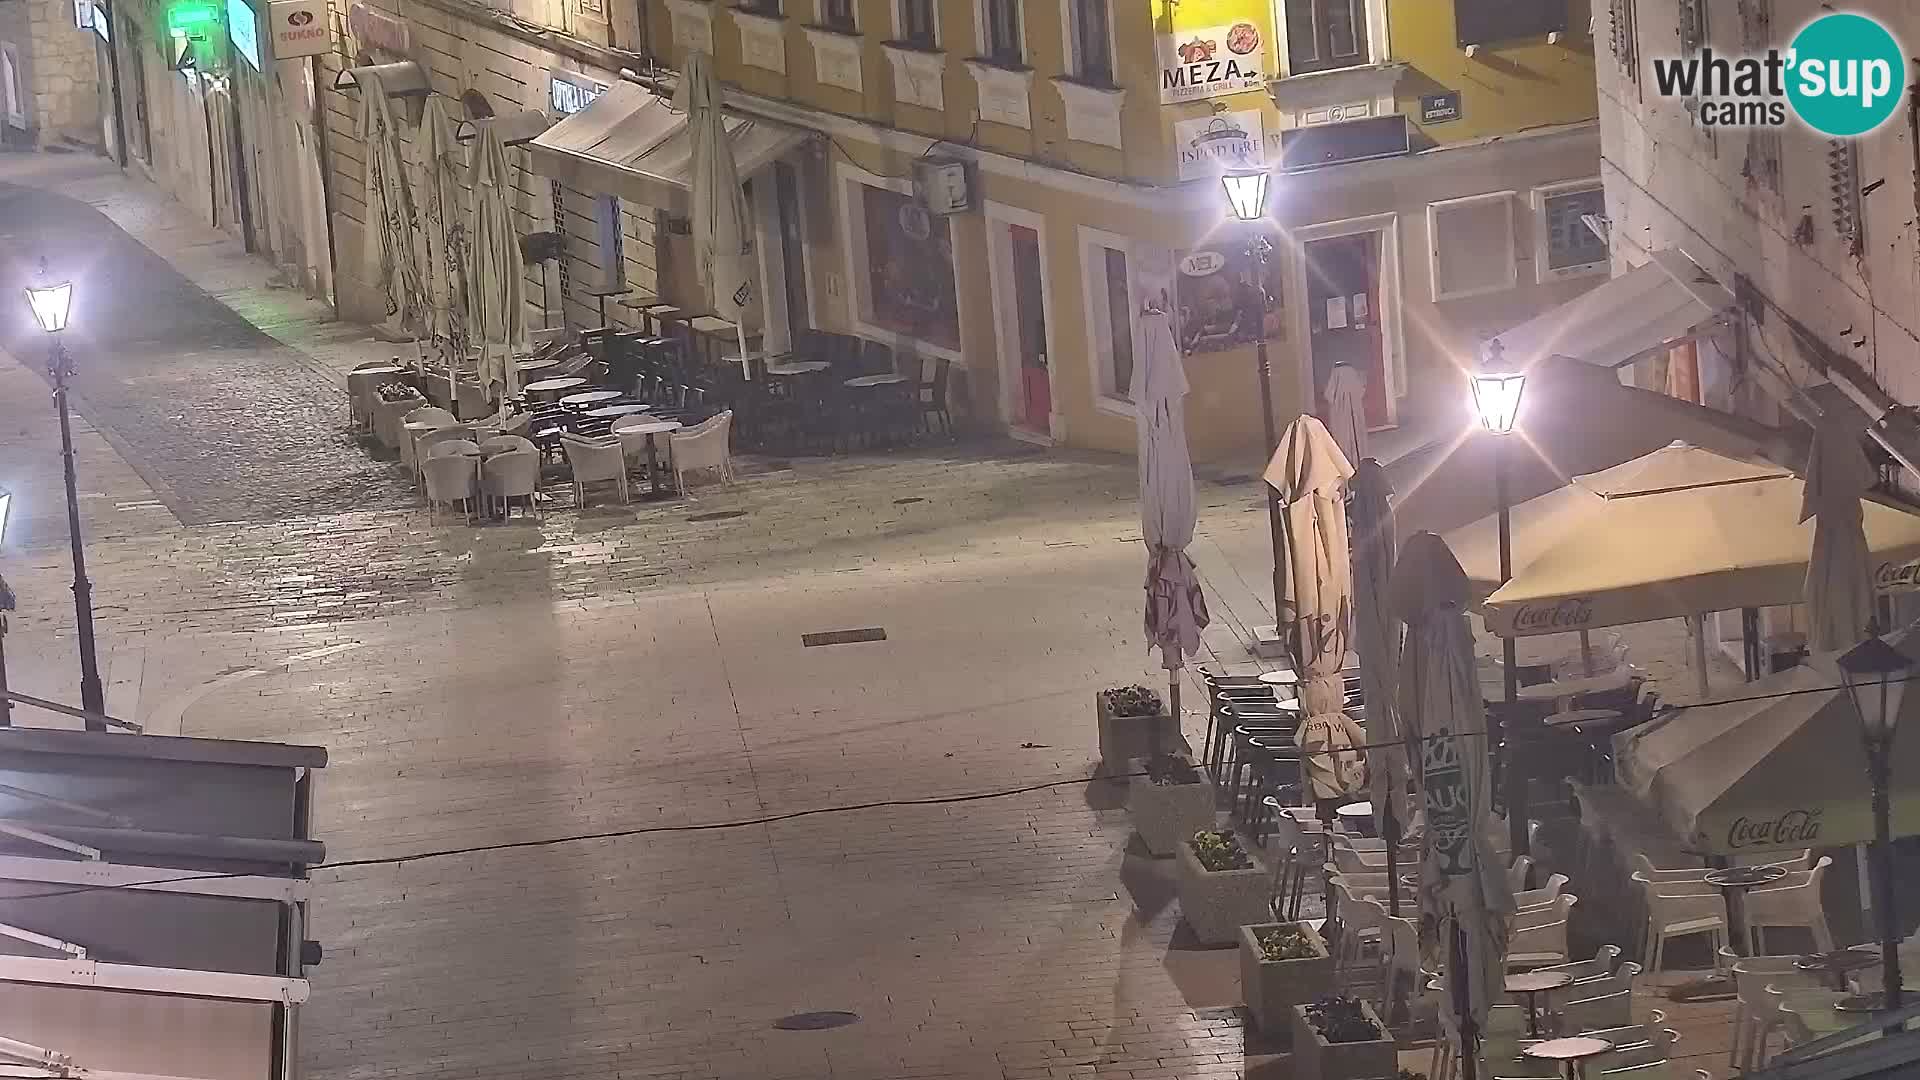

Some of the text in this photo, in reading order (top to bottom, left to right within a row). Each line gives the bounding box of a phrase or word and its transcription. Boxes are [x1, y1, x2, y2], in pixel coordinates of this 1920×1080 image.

[280, 28, 324, 41] SUKNO
[1163, 59, 1241, 89] MEZA
[1172, 85, 1205, 97] PIZZERIA
[1213, 83, 1233, 93] GRILL
